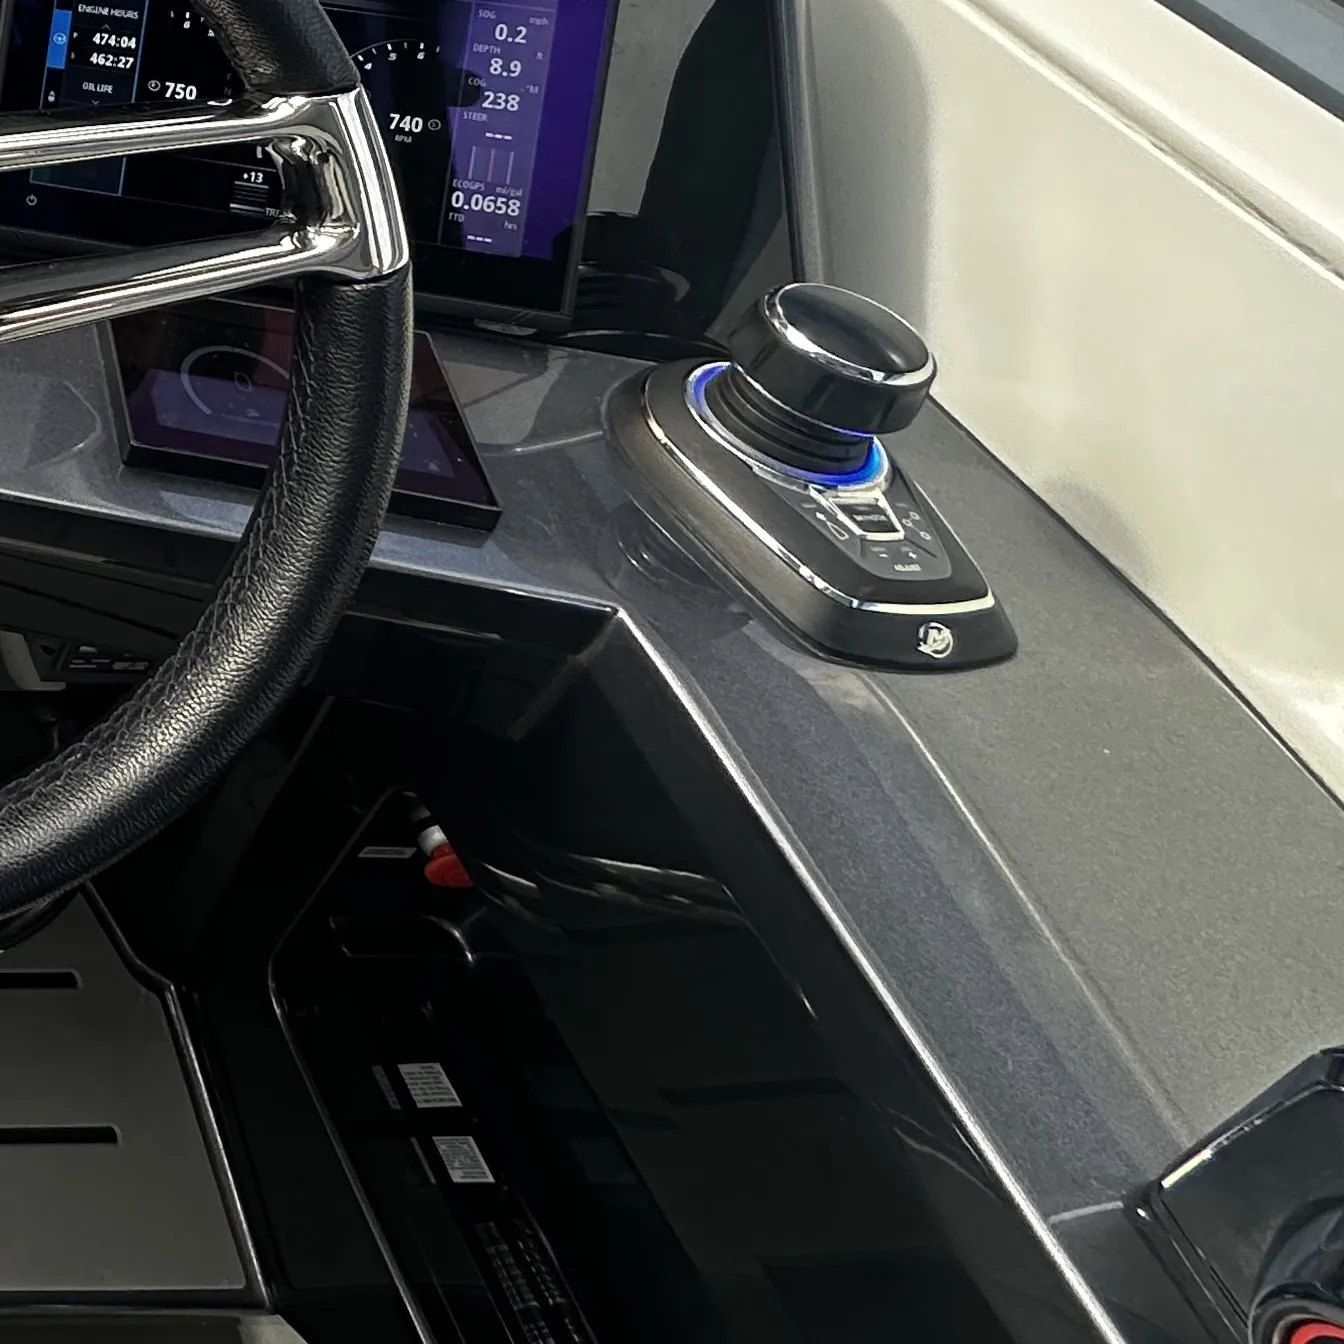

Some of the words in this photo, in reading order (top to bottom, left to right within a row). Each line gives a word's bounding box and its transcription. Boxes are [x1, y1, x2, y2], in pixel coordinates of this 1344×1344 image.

[78, 2, 110, 16] ENGINE
[110, 7, 140, 19] HOURS
[477, 8, 497, 20] SOG
[92, 31, 137, 50] 474:04
[494, 23, 528, 44] 0.2
[472, 42, 502, 56] DEPTH
[89, 51, 135, 69] 462:27
[488, 57, 523, 78] 8.9
[82, 80, 97, 92] OIL
[96, 83, 114, 95] LIFE
[165, 80, 197, 101] 750
[467, 76, 487, 88] COG
[481, 90, 521, 113] 238
[389, 112, 424, 133] 740
[462, 110, 489, 123] STEER
[452, 178, 486, 192] ECOGPS
[450, 190, 522, 217] 0.0658
[503, 219, 518, 231] hrs
